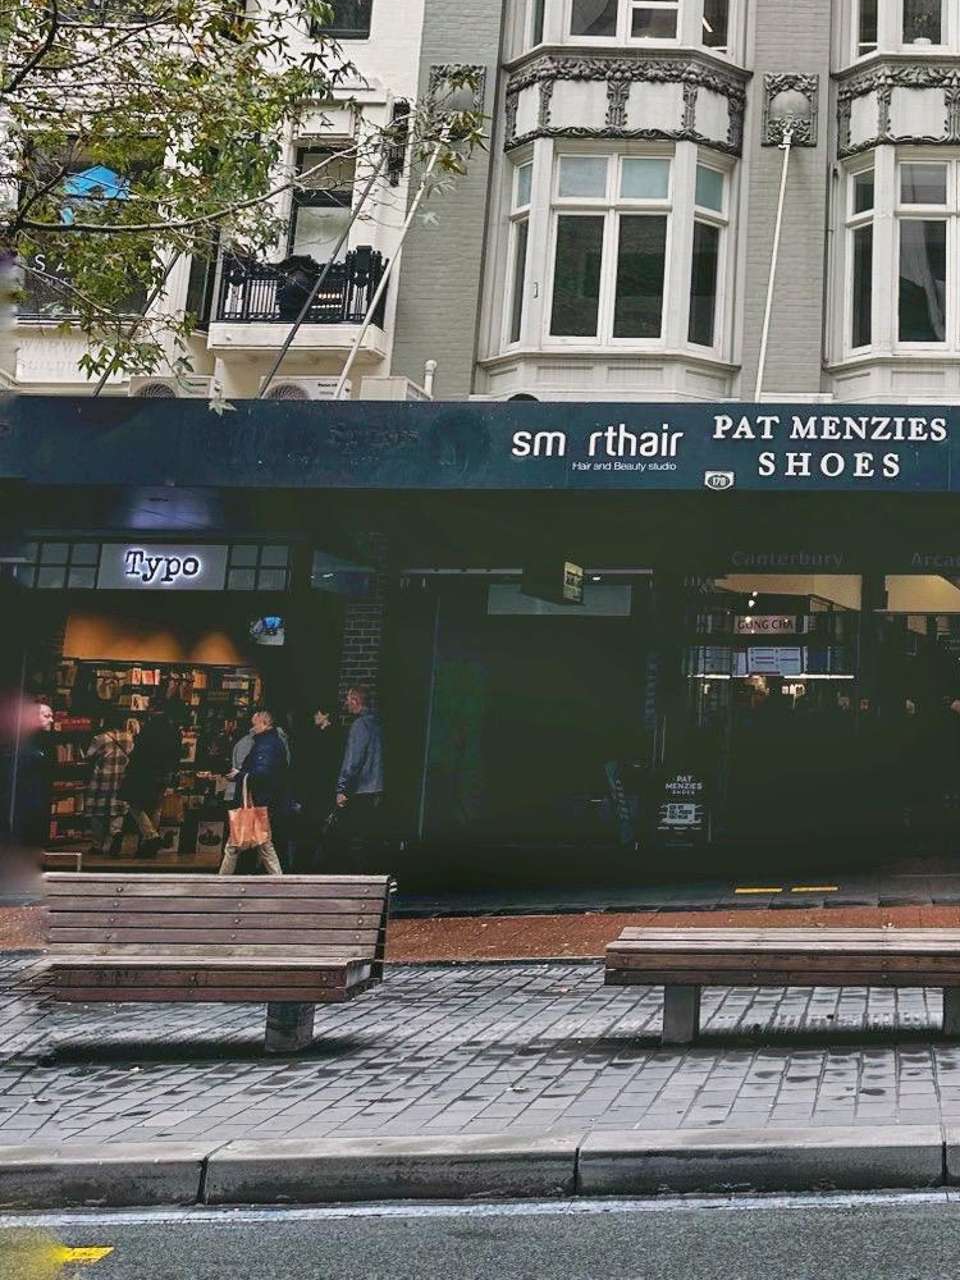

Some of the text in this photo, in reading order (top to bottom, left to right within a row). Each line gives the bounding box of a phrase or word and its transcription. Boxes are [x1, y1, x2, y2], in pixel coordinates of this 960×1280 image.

[713, 415, 947, 442] PAT MENZIES
[572, 462, 676, 472] Hair and Beauty studio
[758, 451, 900, 477] SHOES
[125, 550, 200, 581] Typo
[731, 551, 844, 568] Canterbury
